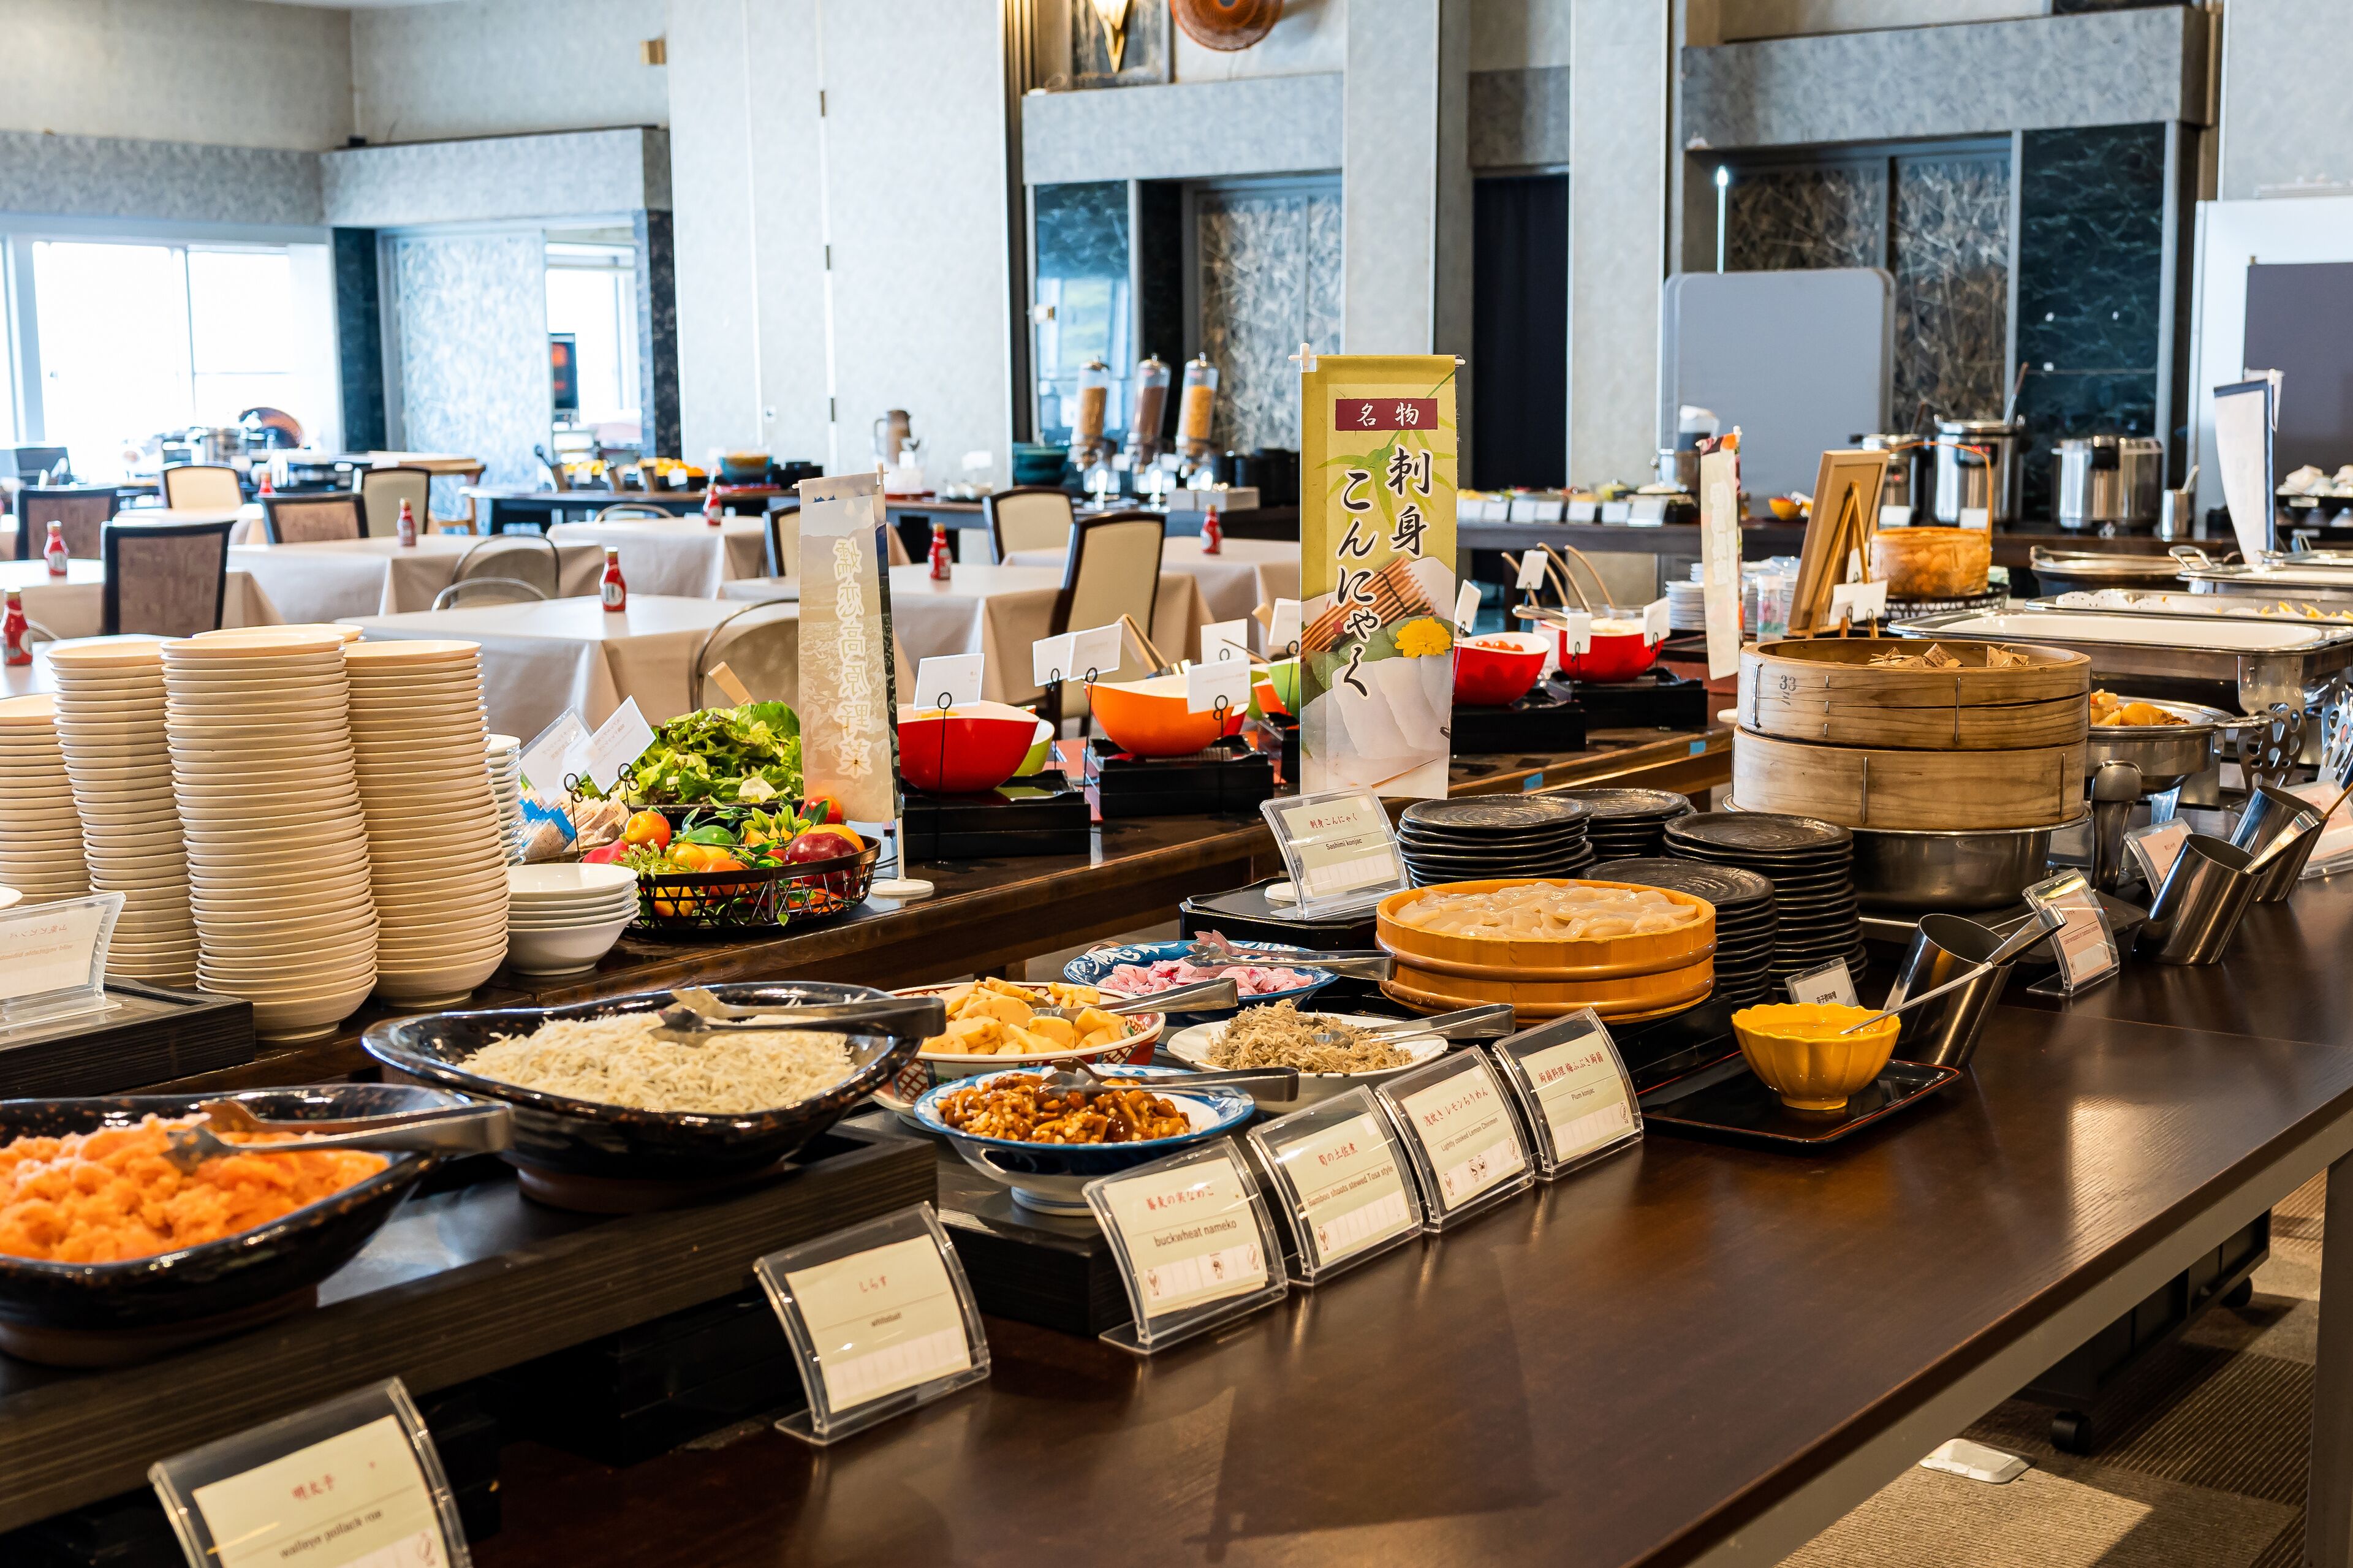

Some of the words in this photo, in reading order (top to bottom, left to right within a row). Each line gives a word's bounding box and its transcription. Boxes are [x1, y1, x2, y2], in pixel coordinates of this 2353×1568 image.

[1357, 403, 1419, 427] 名物
[1388, 447, 1431, 556] 刺身
[1336, 472, 1379, 697] こんにゃく
[1309, 813, 1357, 828] 刺身こんにゃく
[1326, 841, 1346, 850] Sashimi
[1346, 838, 1362, 847] konjac
[1446, 1087, 1488, 1115] レモンちりめん
[1441, 1141, 1455, 1151] Lightly
[1455, 1134, 1469, 1146] cooked
[1468, 1126, 1482, 1138] Lemon
[1318, 1142, 1358, 1166] 筍の土佐煮
[1308, 1192, 1330, 1206] Bamboo
[1330, 1185, 1349, 1197] shoots
[1348, 1176, 1368, 1190] stewed
[1366, 1171, 1381, 1184] Tosa
[1379, 1165, 1393, 1177] style
[1153, 1227, 1203, 1247] buckwheat
[1203, 1219, 1237, 1235] nameko
